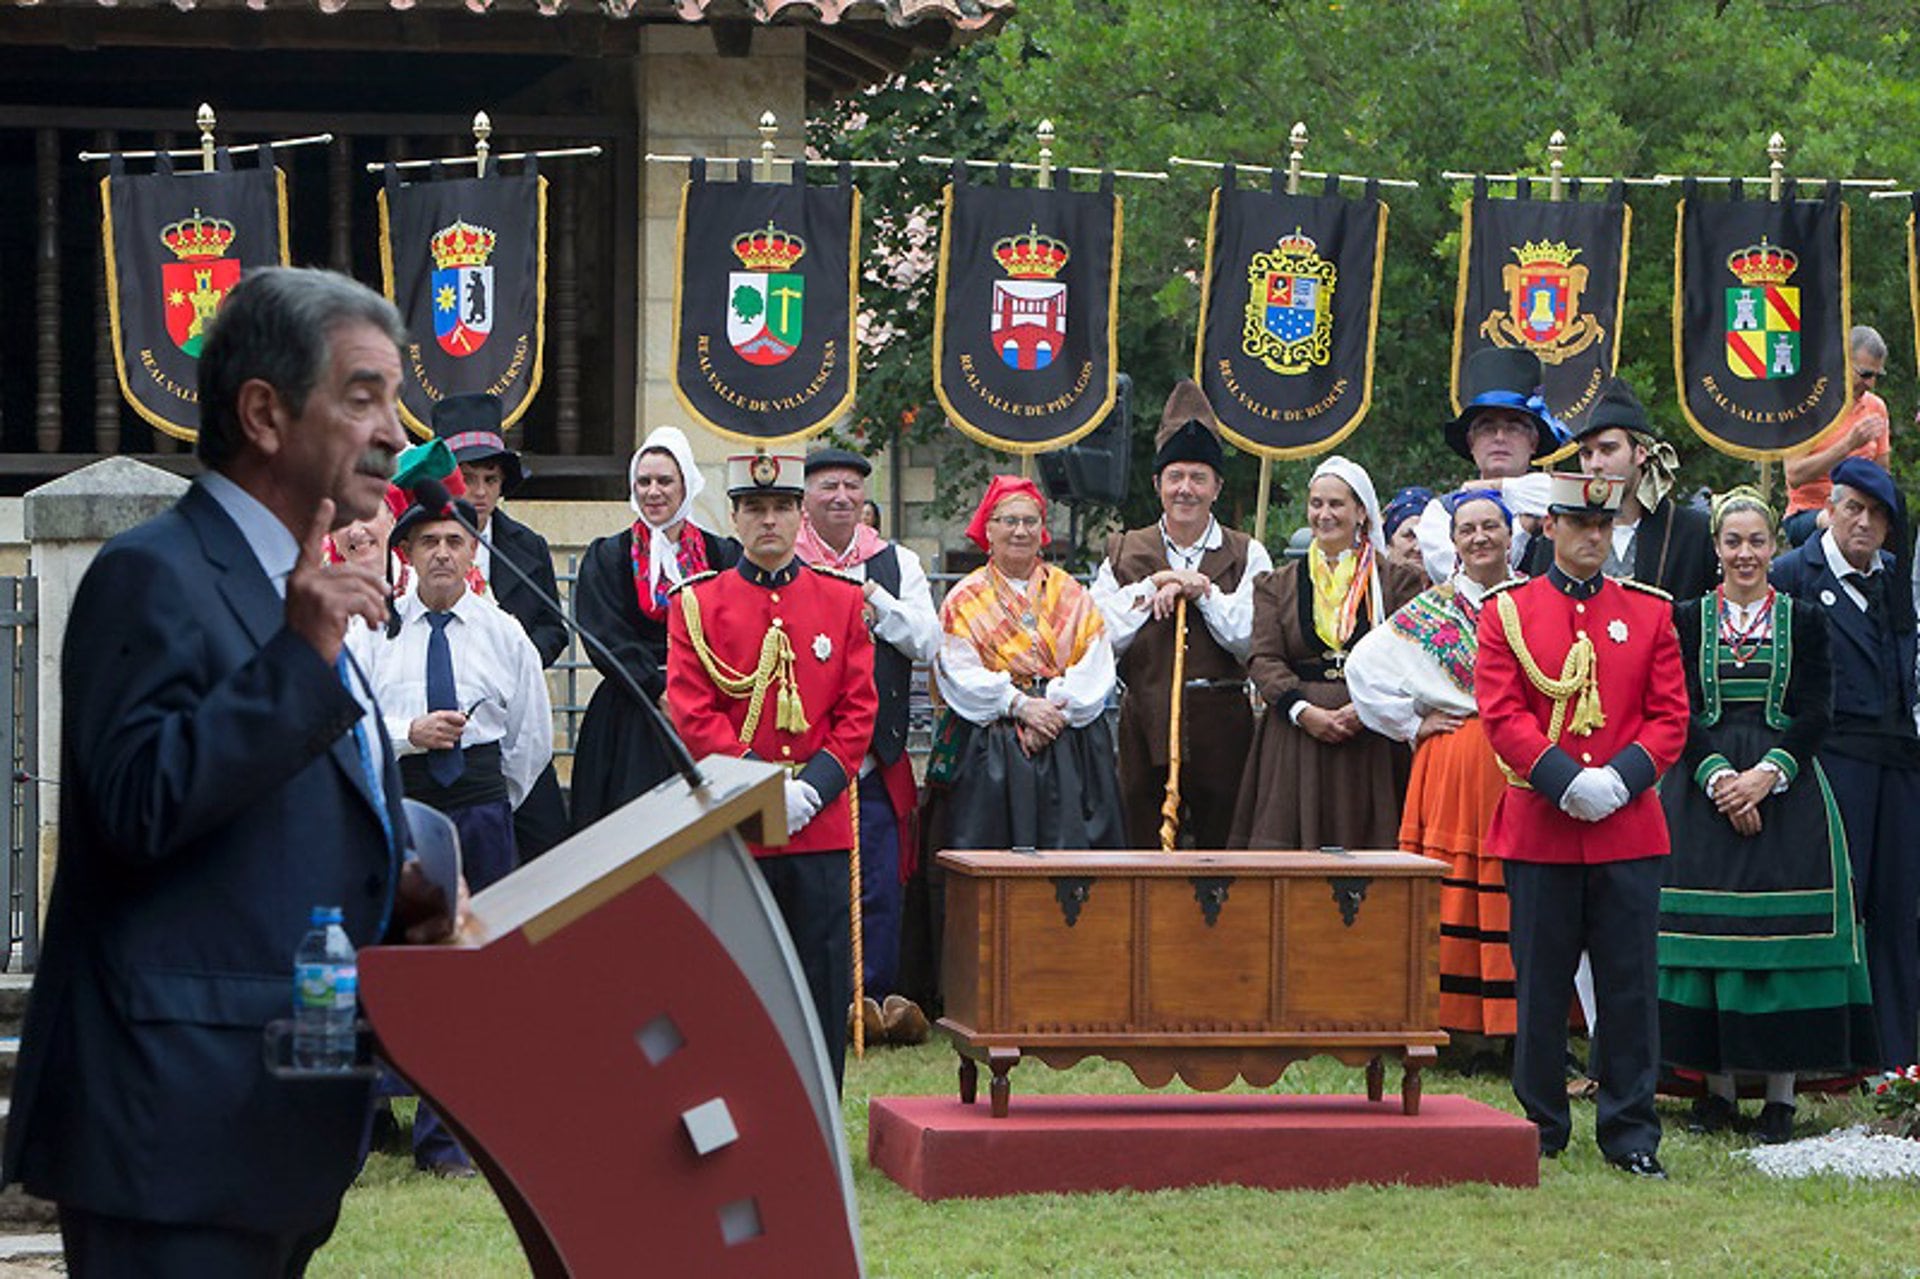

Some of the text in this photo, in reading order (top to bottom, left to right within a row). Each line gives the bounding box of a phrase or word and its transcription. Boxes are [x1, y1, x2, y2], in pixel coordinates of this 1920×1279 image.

[140, 347, 200, 404] REAL VALL
[410, 343, 425, 379] REAL
[422, 378, 446, 402] VALL
[698, 335, 712, 373] REAL
[708, 371, 747, 409] VALLE
[748, 399, 770, 412] DE
[960, 354, 980, 392] REAL
[980, 387, 1022, 416] VALLE
[1024, 405, 1046, 416] DE
[1218, 359, 1240, 397] REAL
[1238, 392, 1280, 420] VALLE
[1283, 409, 1304, 421] DE
[1702, 374, 1730, 411] REAL
[1730, 403, 1777, 424] VALLE
[1778, 408, 1798, 422] DE
